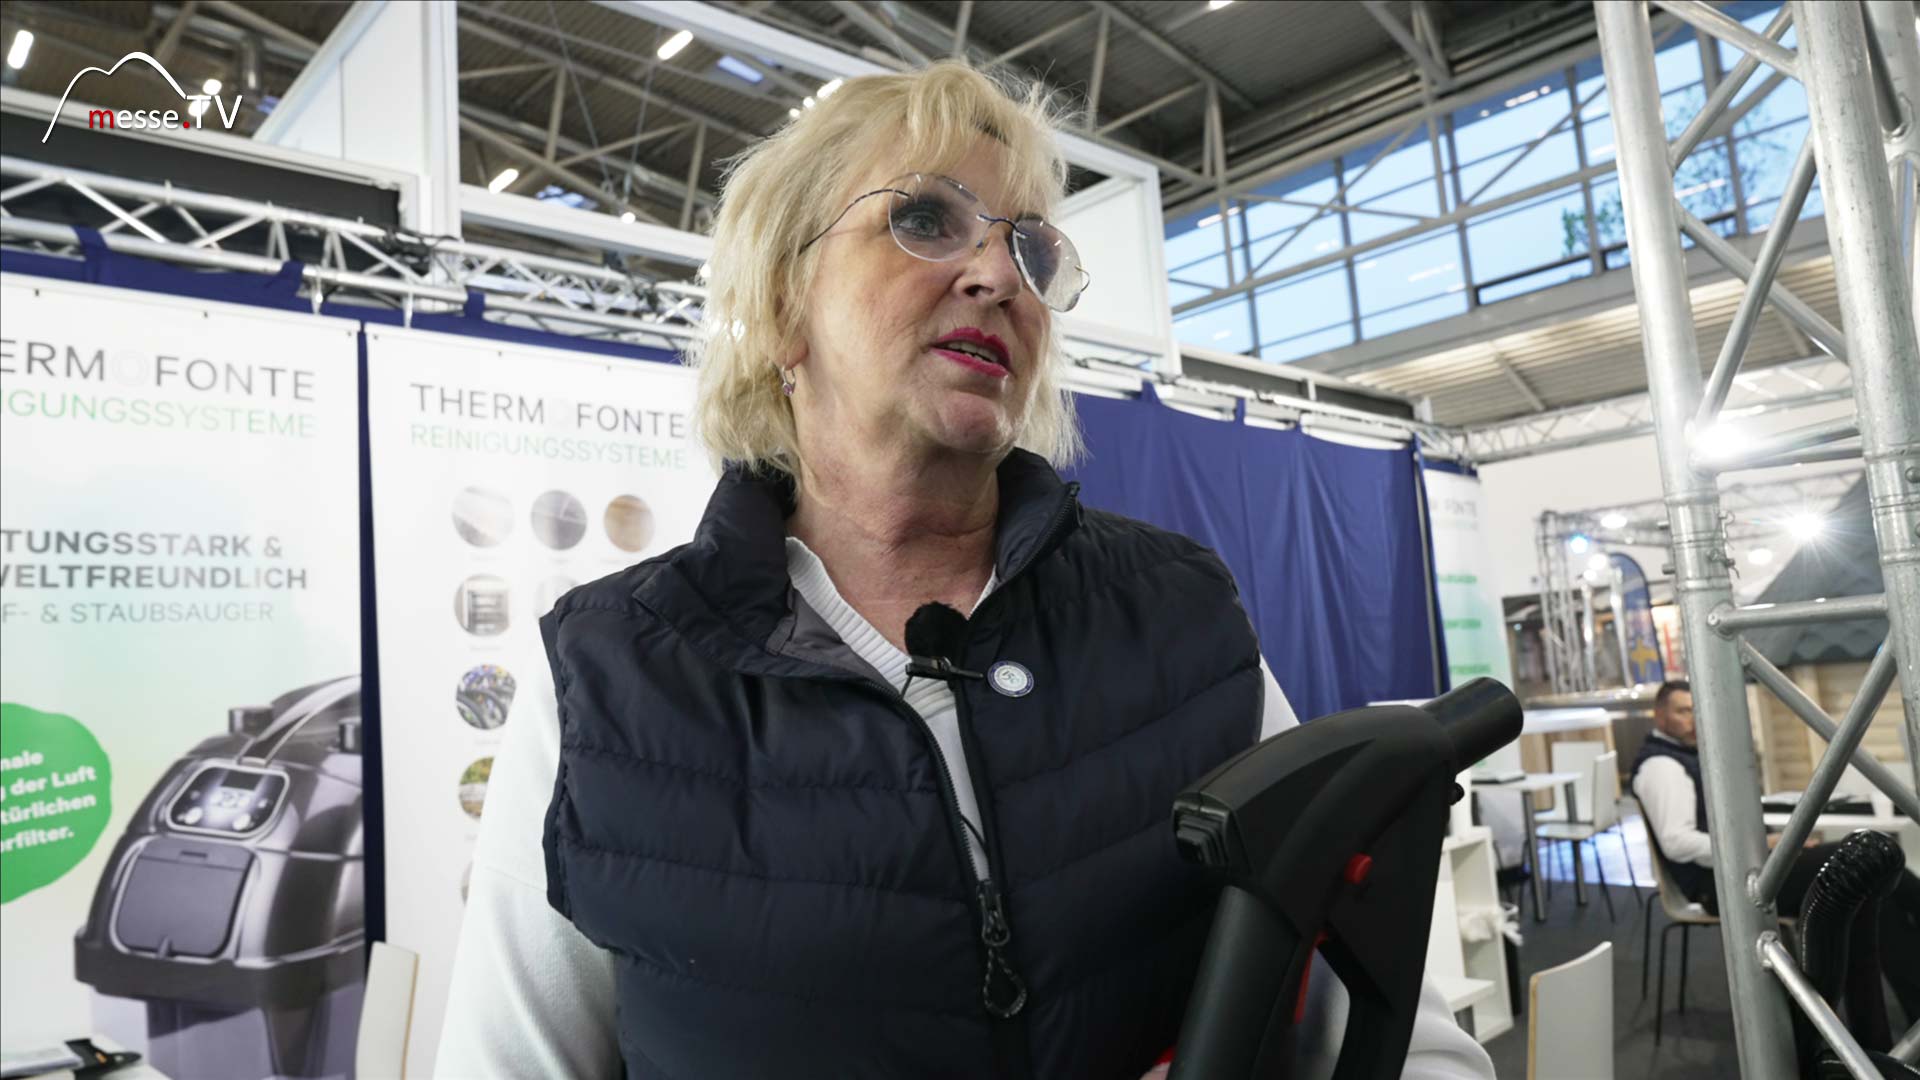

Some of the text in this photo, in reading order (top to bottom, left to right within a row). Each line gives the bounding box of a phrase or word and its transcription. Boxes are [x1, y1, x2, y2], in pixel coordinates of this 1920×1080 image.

[411, 424, 688, 469] REINIGUNGSSYSTEME
[0, 530, 282, 558] TUNGSSTARK &
[41, 603, 59, 623] &
[70, 603, 273, 623] STAUBSAUGER
[10, 778, 46, 795] der
[51, 766, 96, 788] Luft
